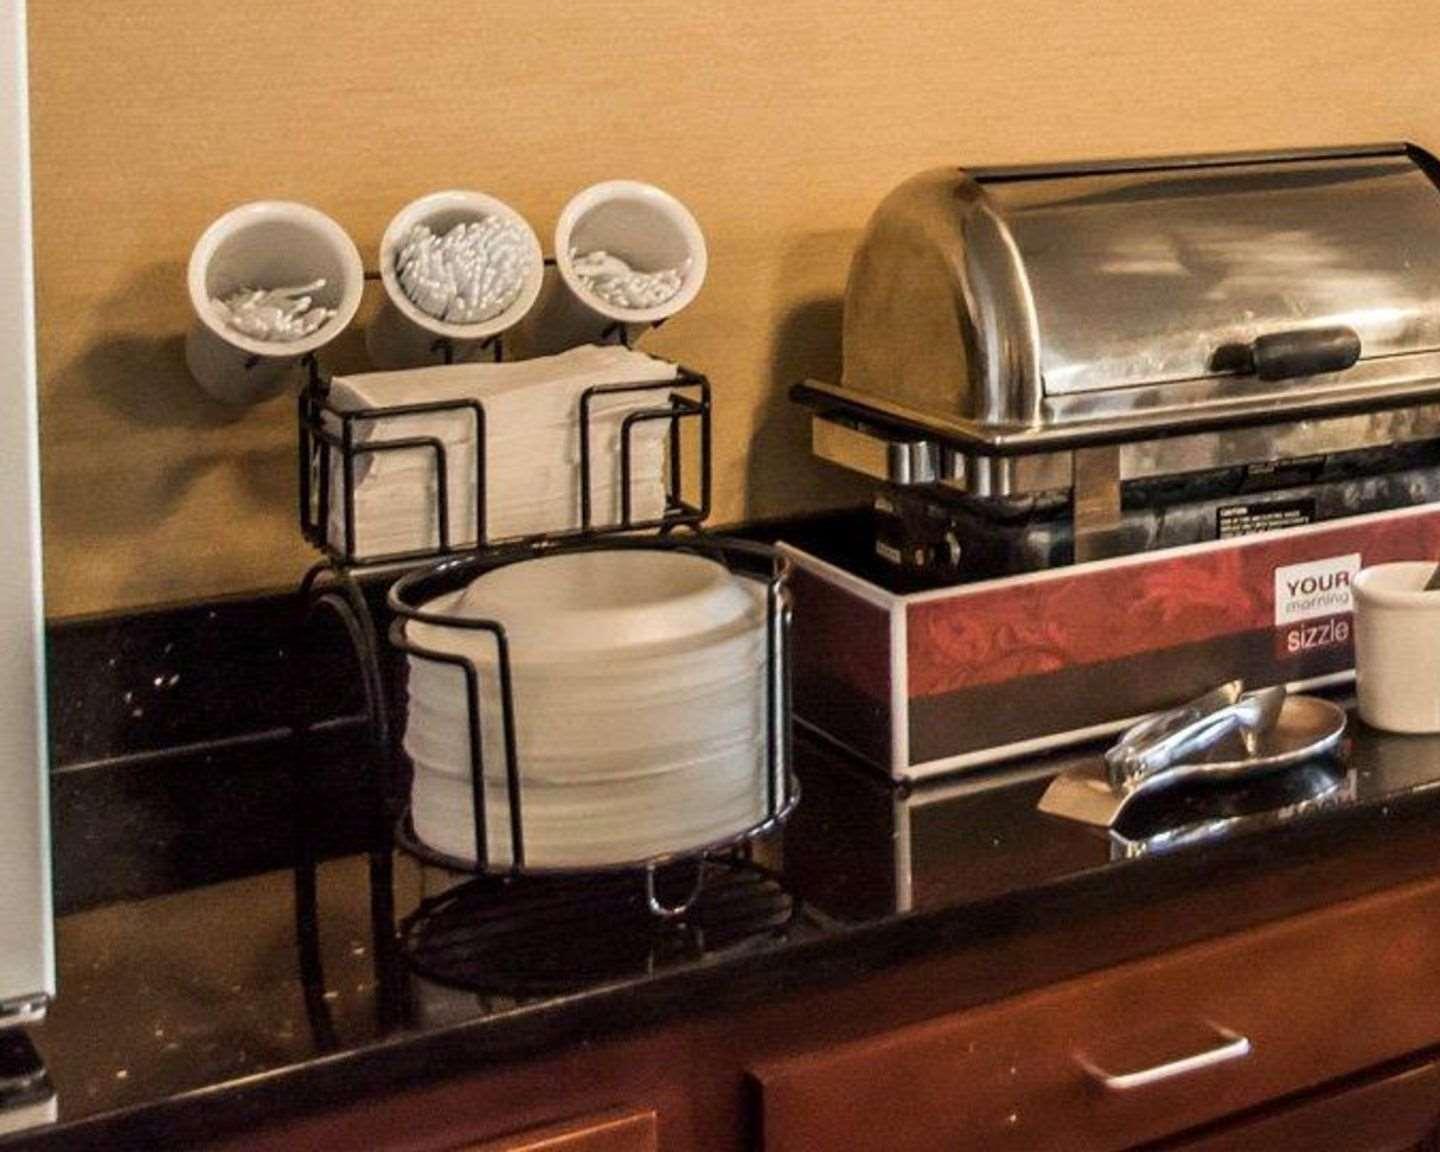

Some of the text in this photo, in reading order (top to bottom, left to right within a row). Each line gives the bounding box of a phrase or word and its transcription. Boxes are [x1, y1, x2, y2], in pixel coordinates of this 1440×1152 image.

[1287, 571, 1350, 596] YOUR
[1286, 591, 1349, 613] morning
[1287, 618, 1349, 652] sizzle
